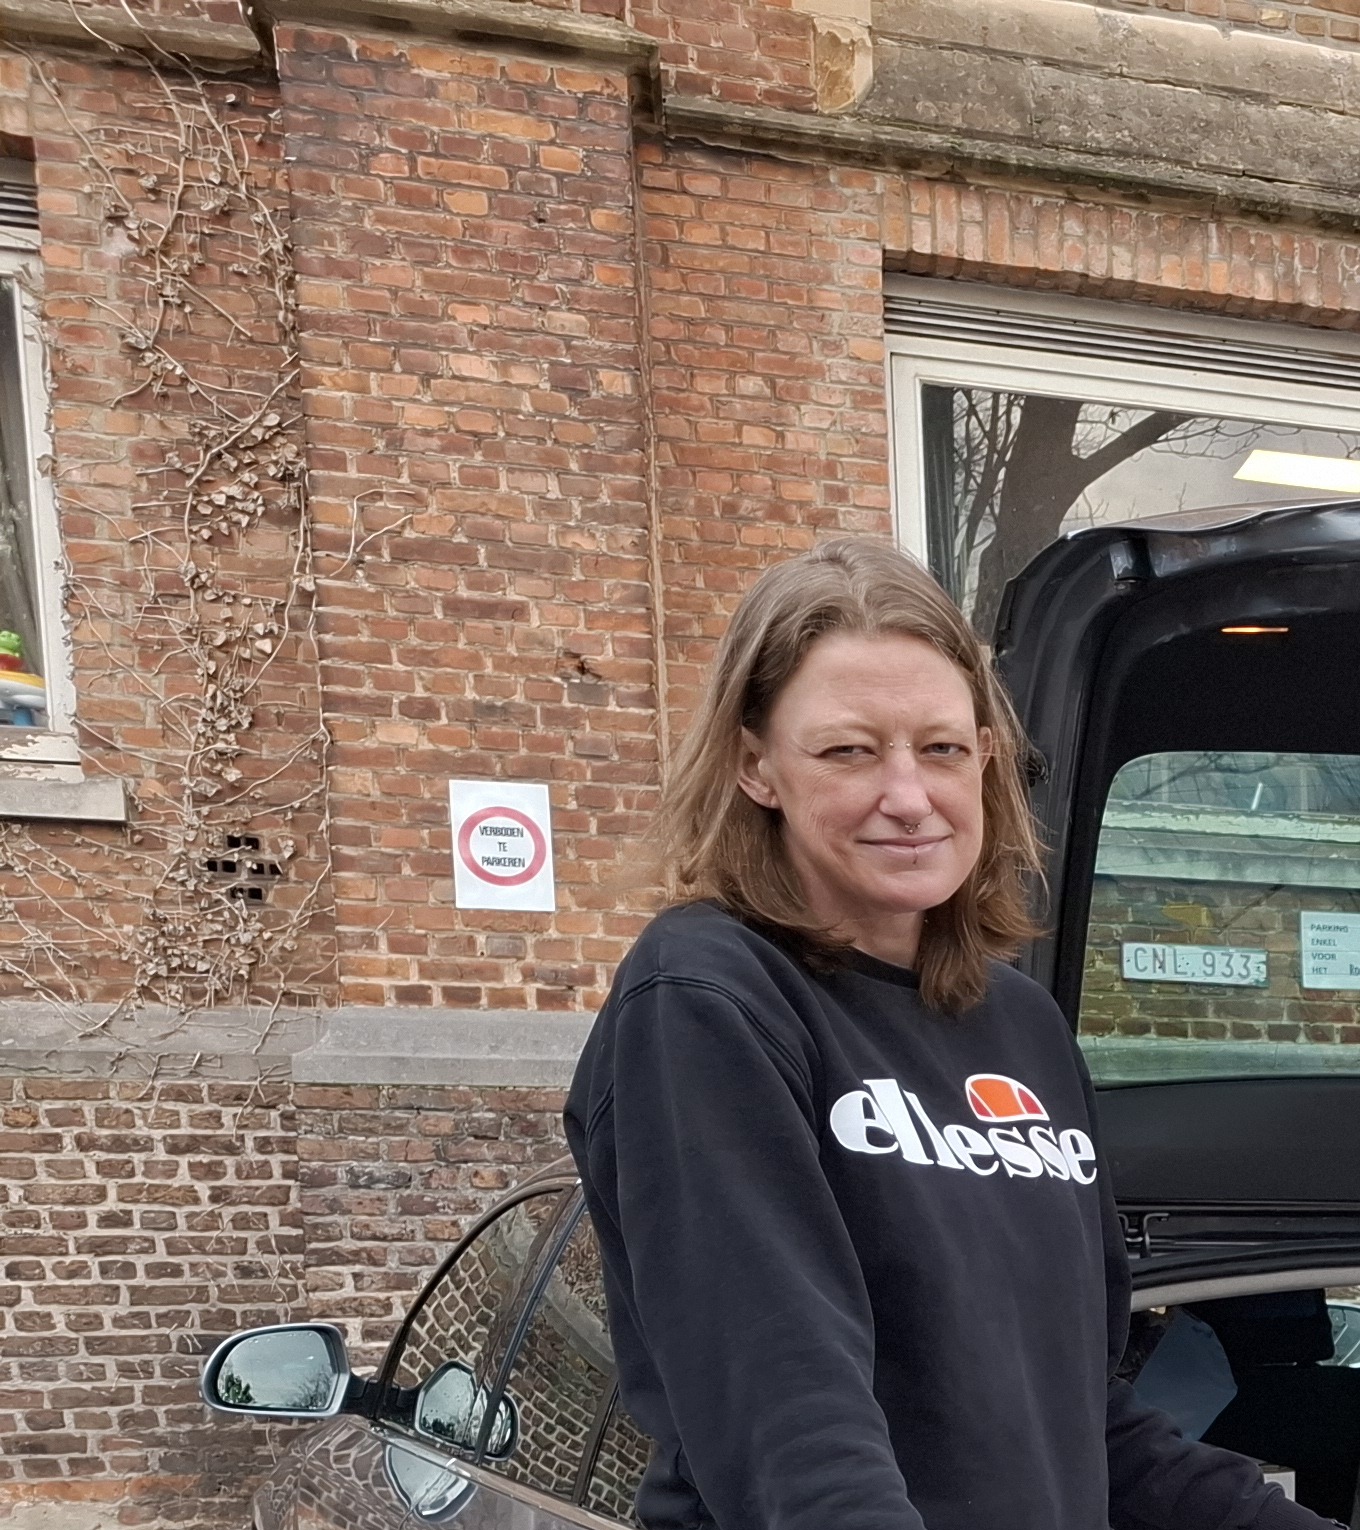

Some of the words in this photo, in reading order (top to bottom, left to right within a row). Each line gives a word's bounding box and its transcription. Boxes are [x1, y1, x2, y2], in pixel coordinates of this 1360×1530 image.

[497, 842, 508, 852] TE
[1310, 923, 1349, 933] PARKING
[1311, 938, 1337, 947] ENKEL
[1311, 952, 1337, 961] VOOR
[1312, 966, 1328, 975] HET
[830, 1079, 1097, 1184] ellesse
